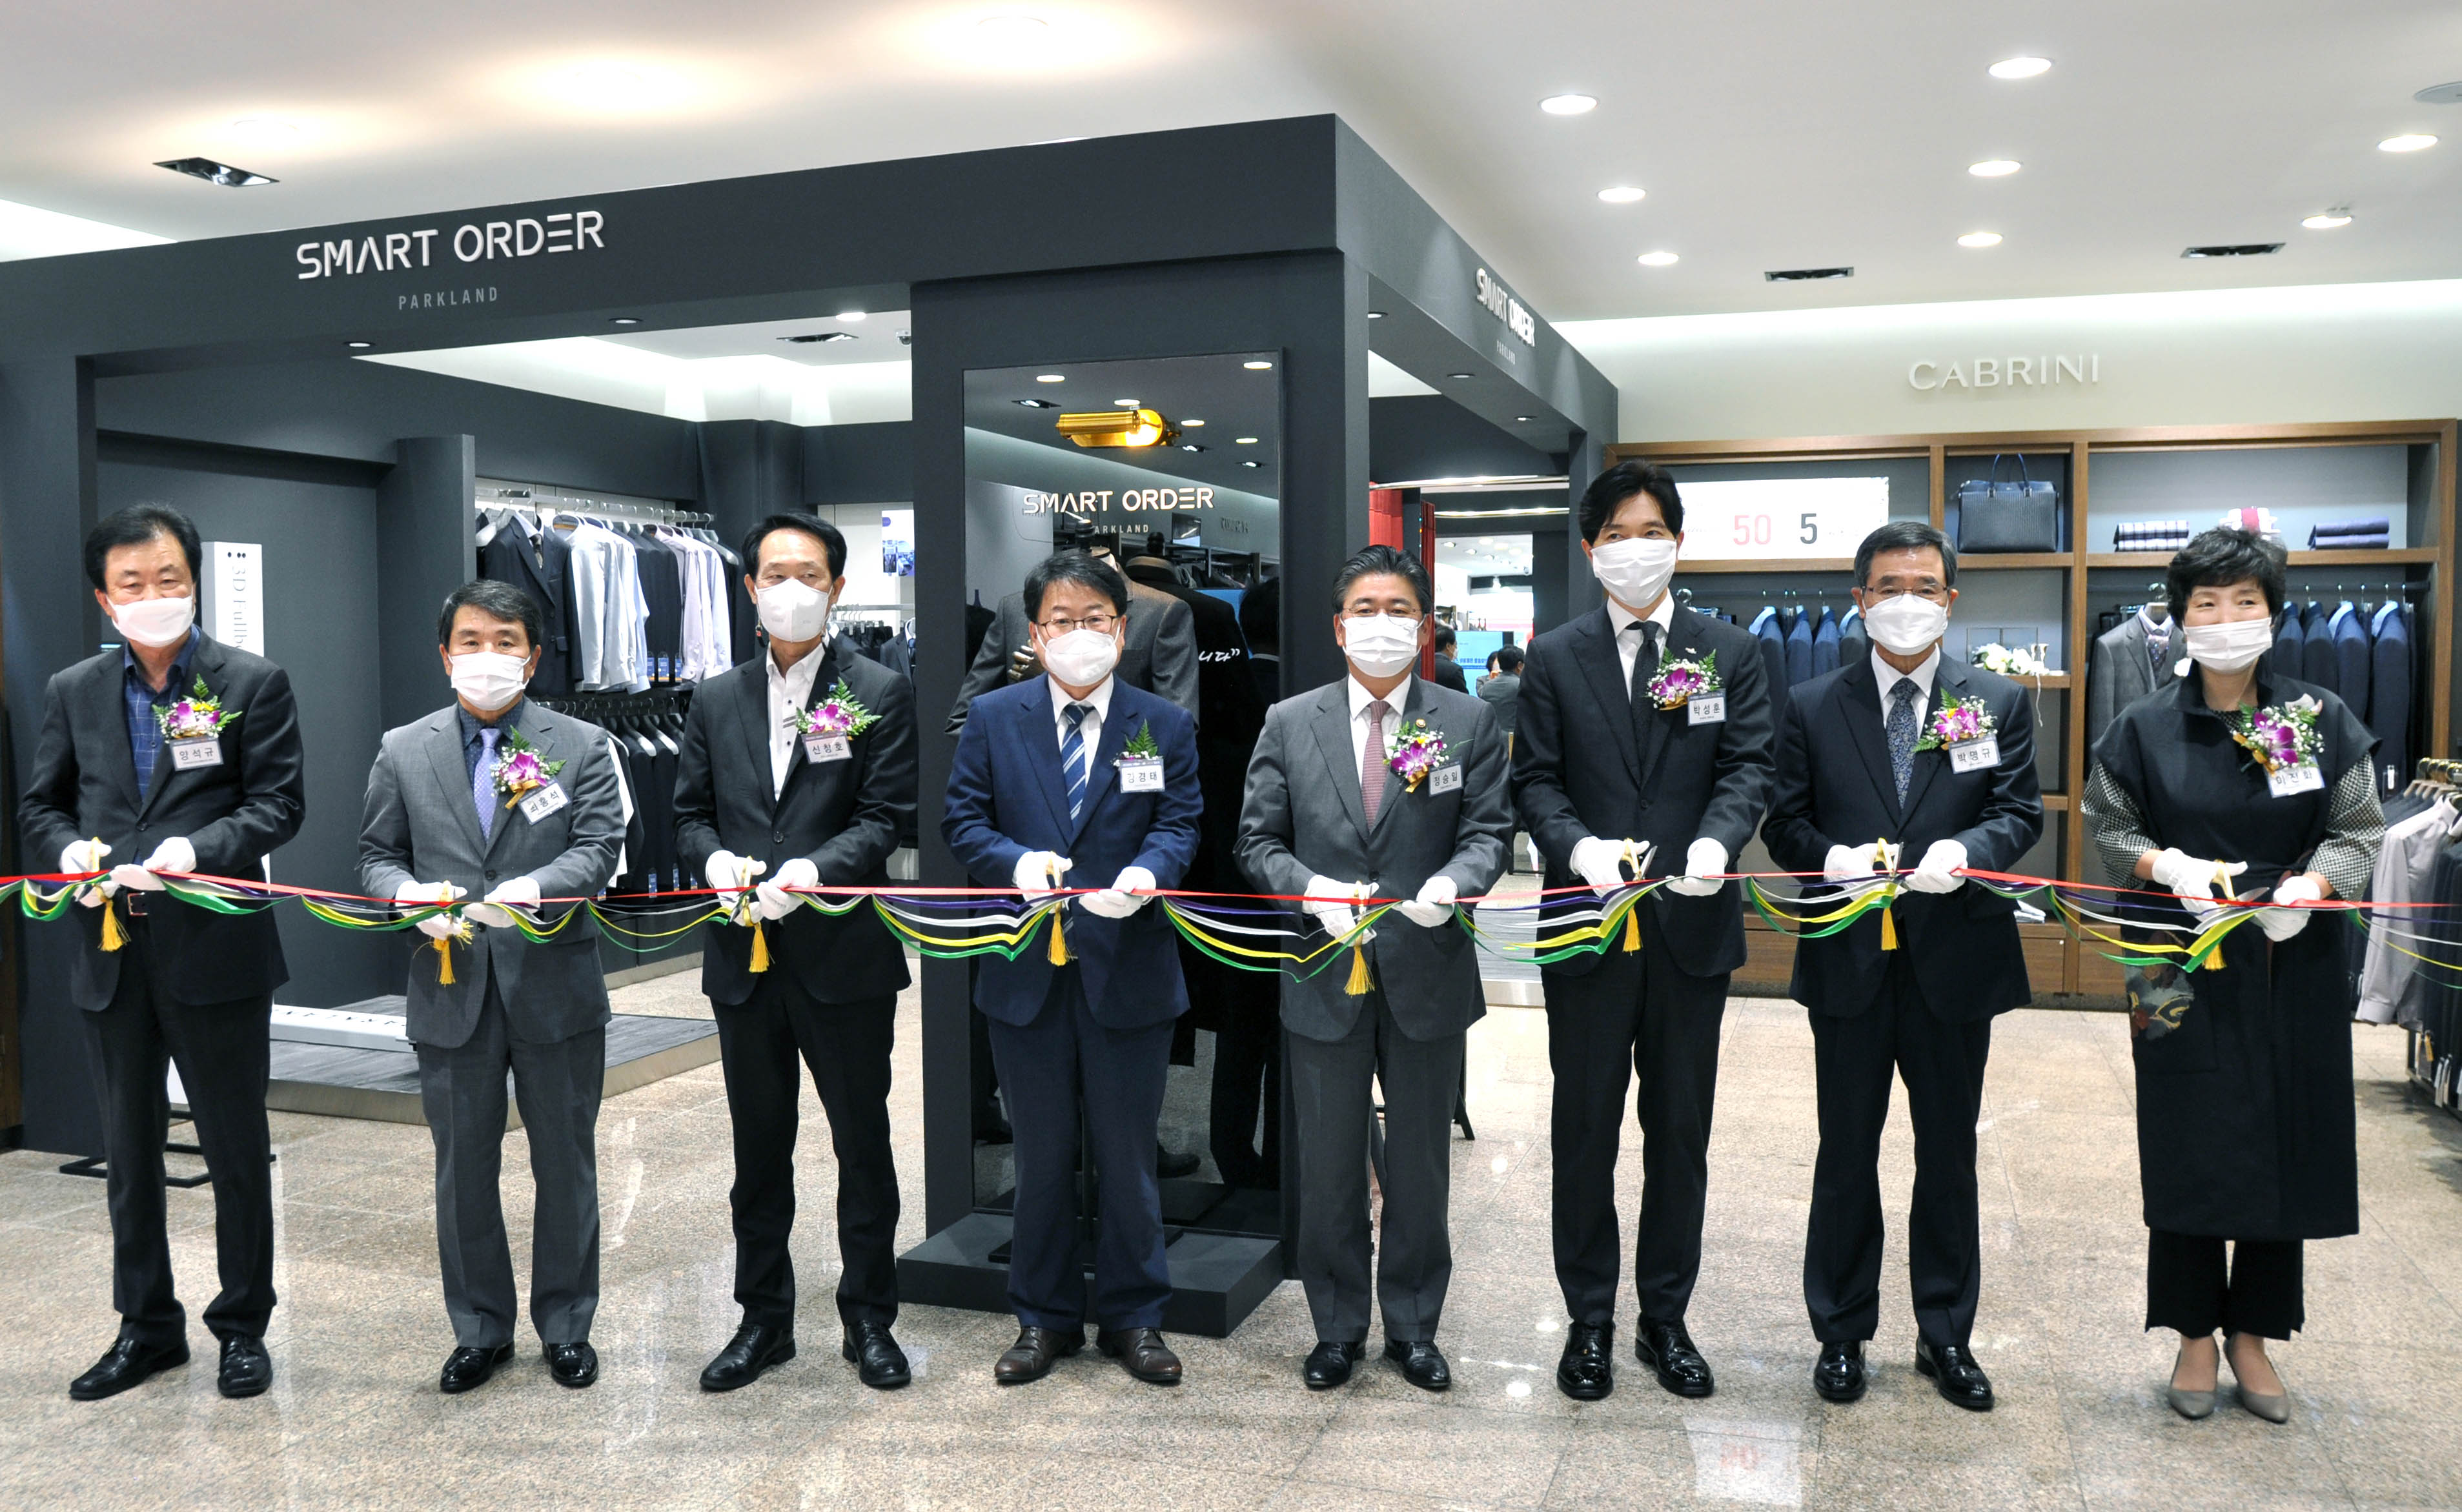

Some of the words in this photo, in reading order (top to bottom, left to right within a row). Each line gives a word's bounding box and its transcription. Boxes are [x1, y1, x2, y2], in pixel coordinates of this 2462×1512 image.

[296, 229, 439, 279] SMART
[454, 210, 605, 262] ORDER
[398, 287, 498, 310] PARKLAND
[1476, 268, 1508, 323] SMART
[1908, 354, 2099, 390] CABRINI
[1023, 490, 1113, 514] SMART
[1122, 487, 1214, 511] ORDER
[1093, 524, 1150, 534] ARKLAND
[1733, 514, 1771, 546] 50
[1957, 748, 1991, 762] 박명규
